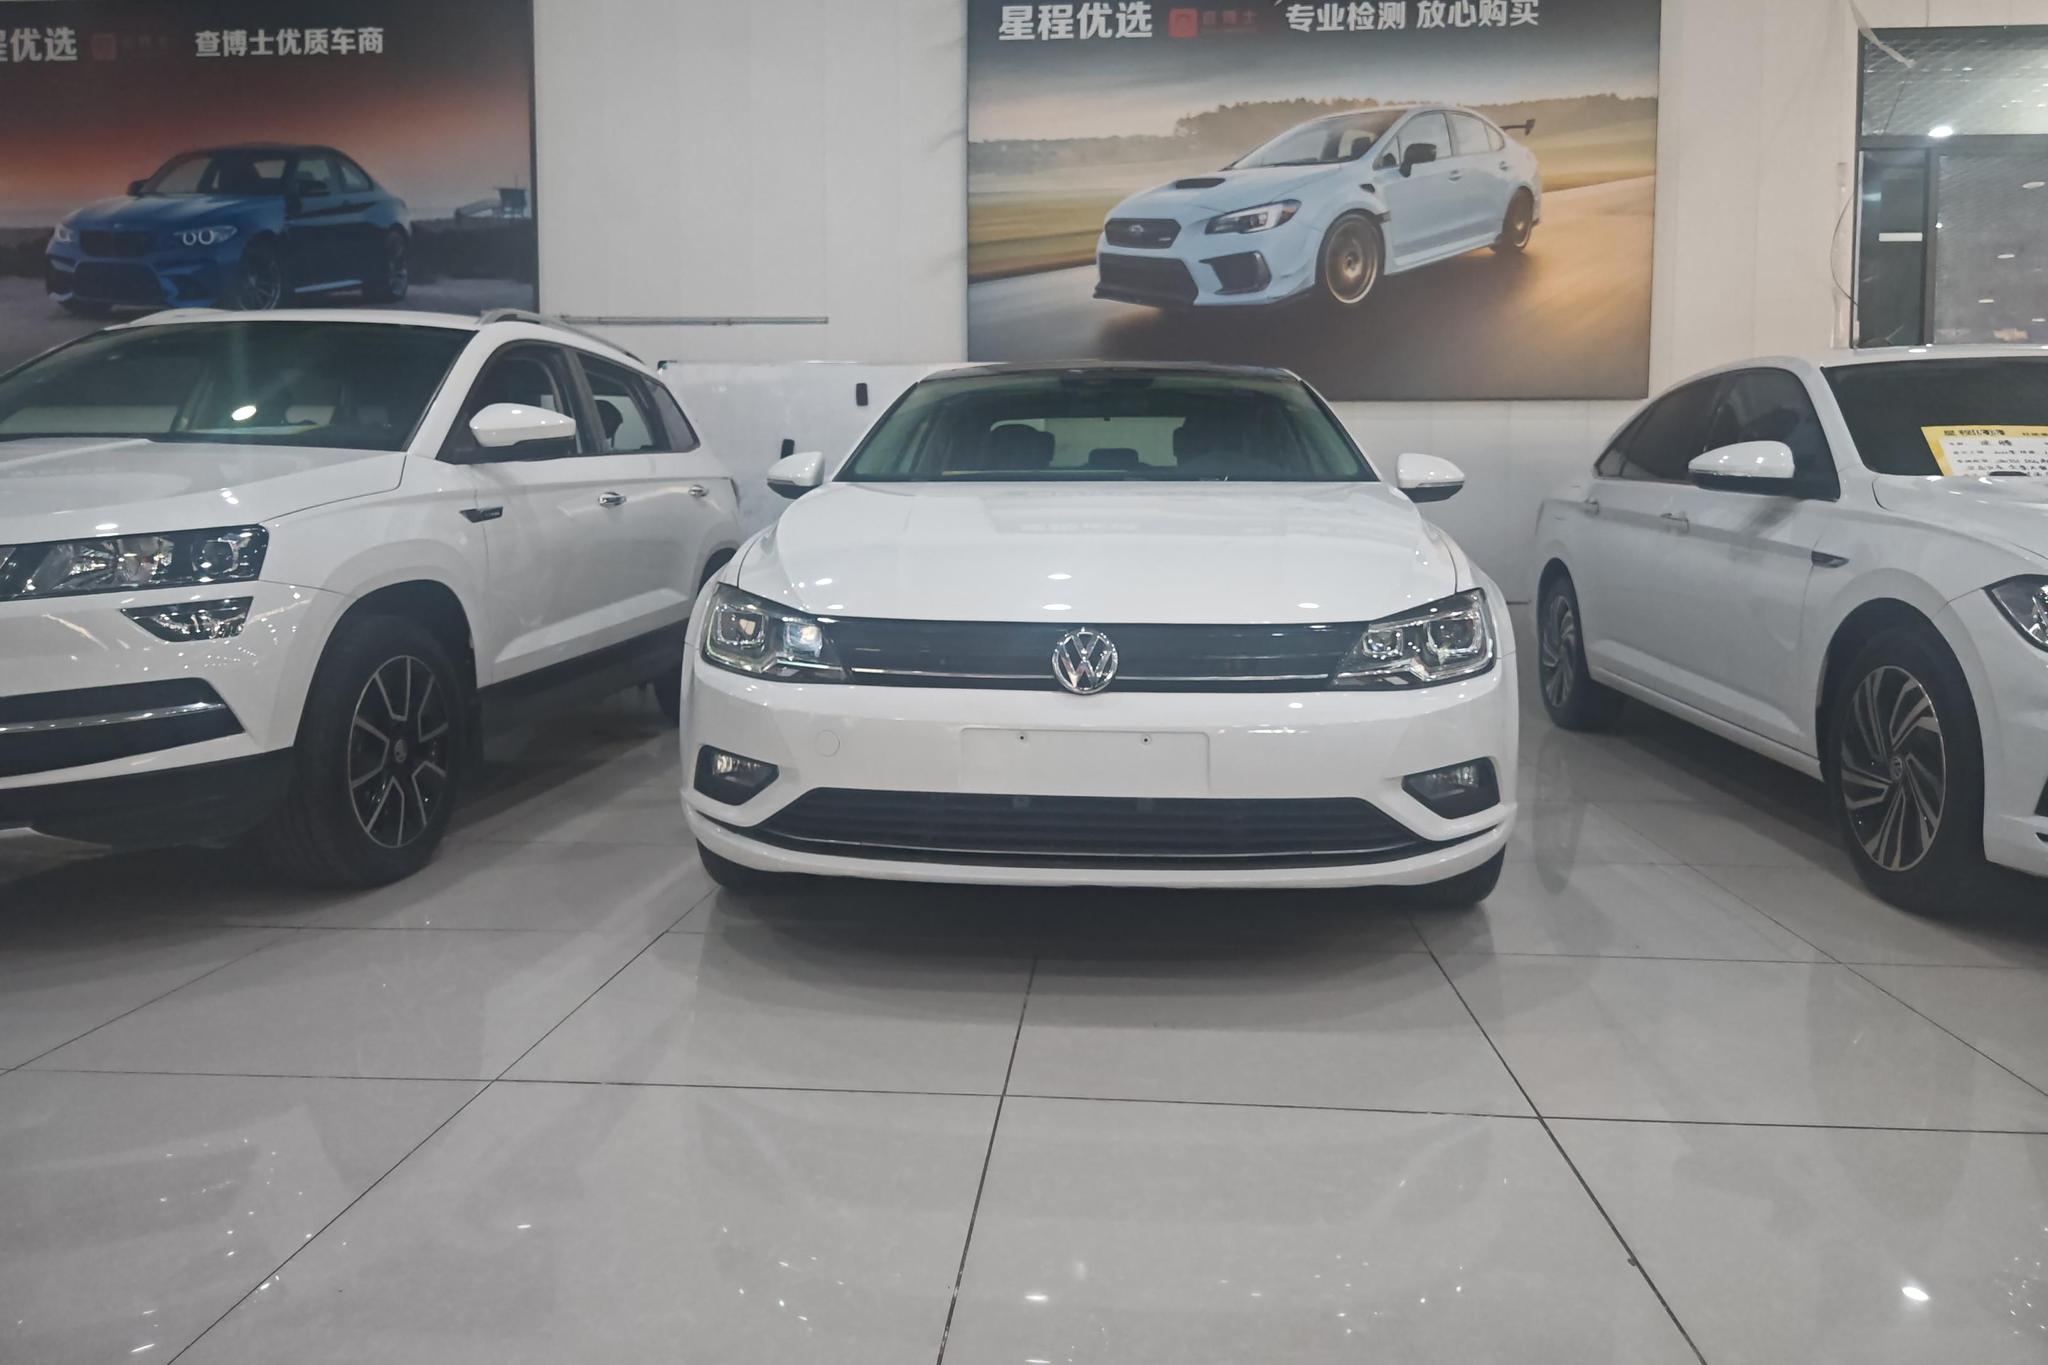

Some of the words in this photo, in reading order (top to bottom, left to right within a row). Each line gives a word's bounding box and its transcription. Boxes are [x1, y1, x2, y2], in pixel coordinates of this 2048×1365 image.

[998, 1, 1153, 41] 星程优选
[1285, 0, 1406, 32] 专业检测
[1416, 0, 1539, 29] 放心购买
[0, 26, 78, 62] 优选
[195, 27, 384, 57] 查博士优质车商
